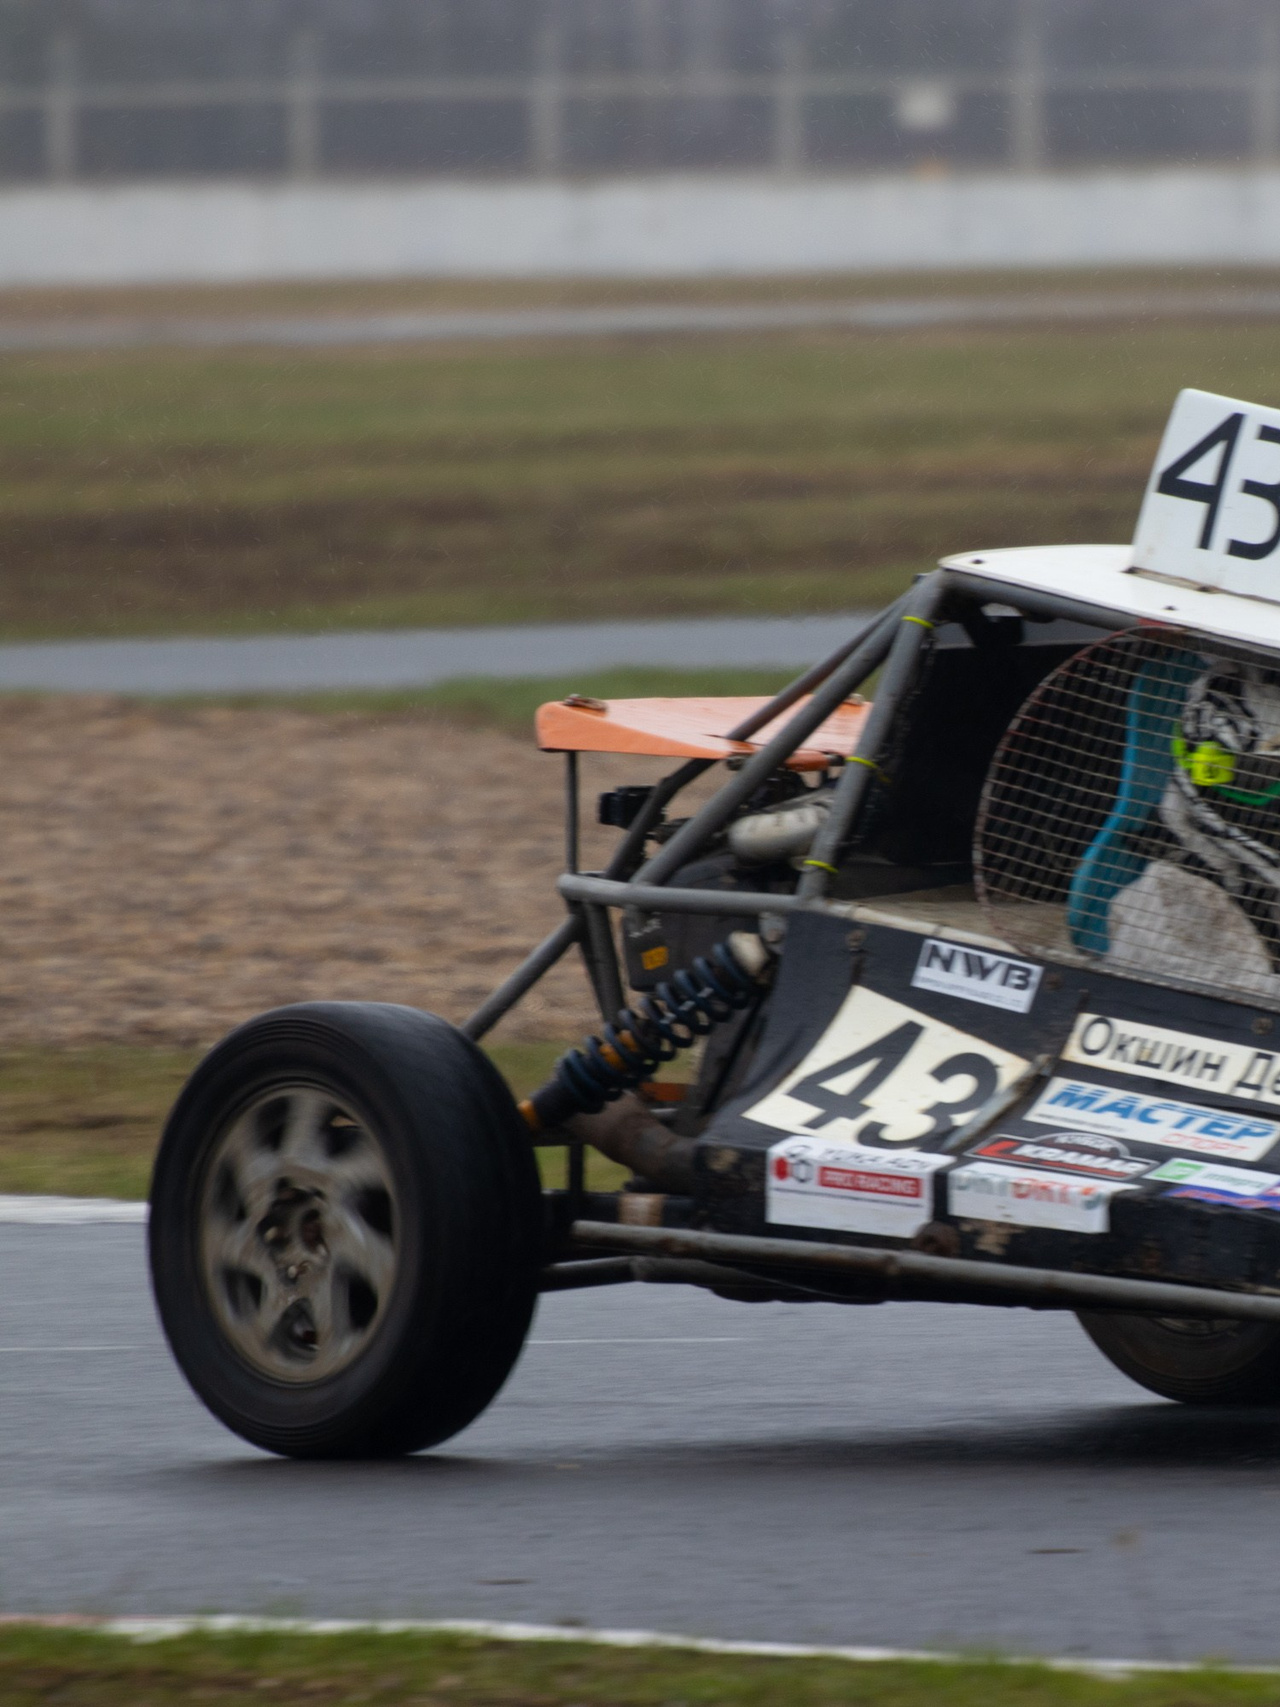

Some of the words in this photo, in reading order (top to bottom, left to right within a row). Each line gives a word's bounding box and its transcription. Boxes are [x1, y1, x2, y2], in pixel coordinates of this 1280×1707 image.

[921, 944, 1033, 991] NWB
[1080, 1017, 1227, 1083] Окшин
[785, 1020, 998, 1150] 43
[1048, 1084, 1277, 1140] МАСТЕР
